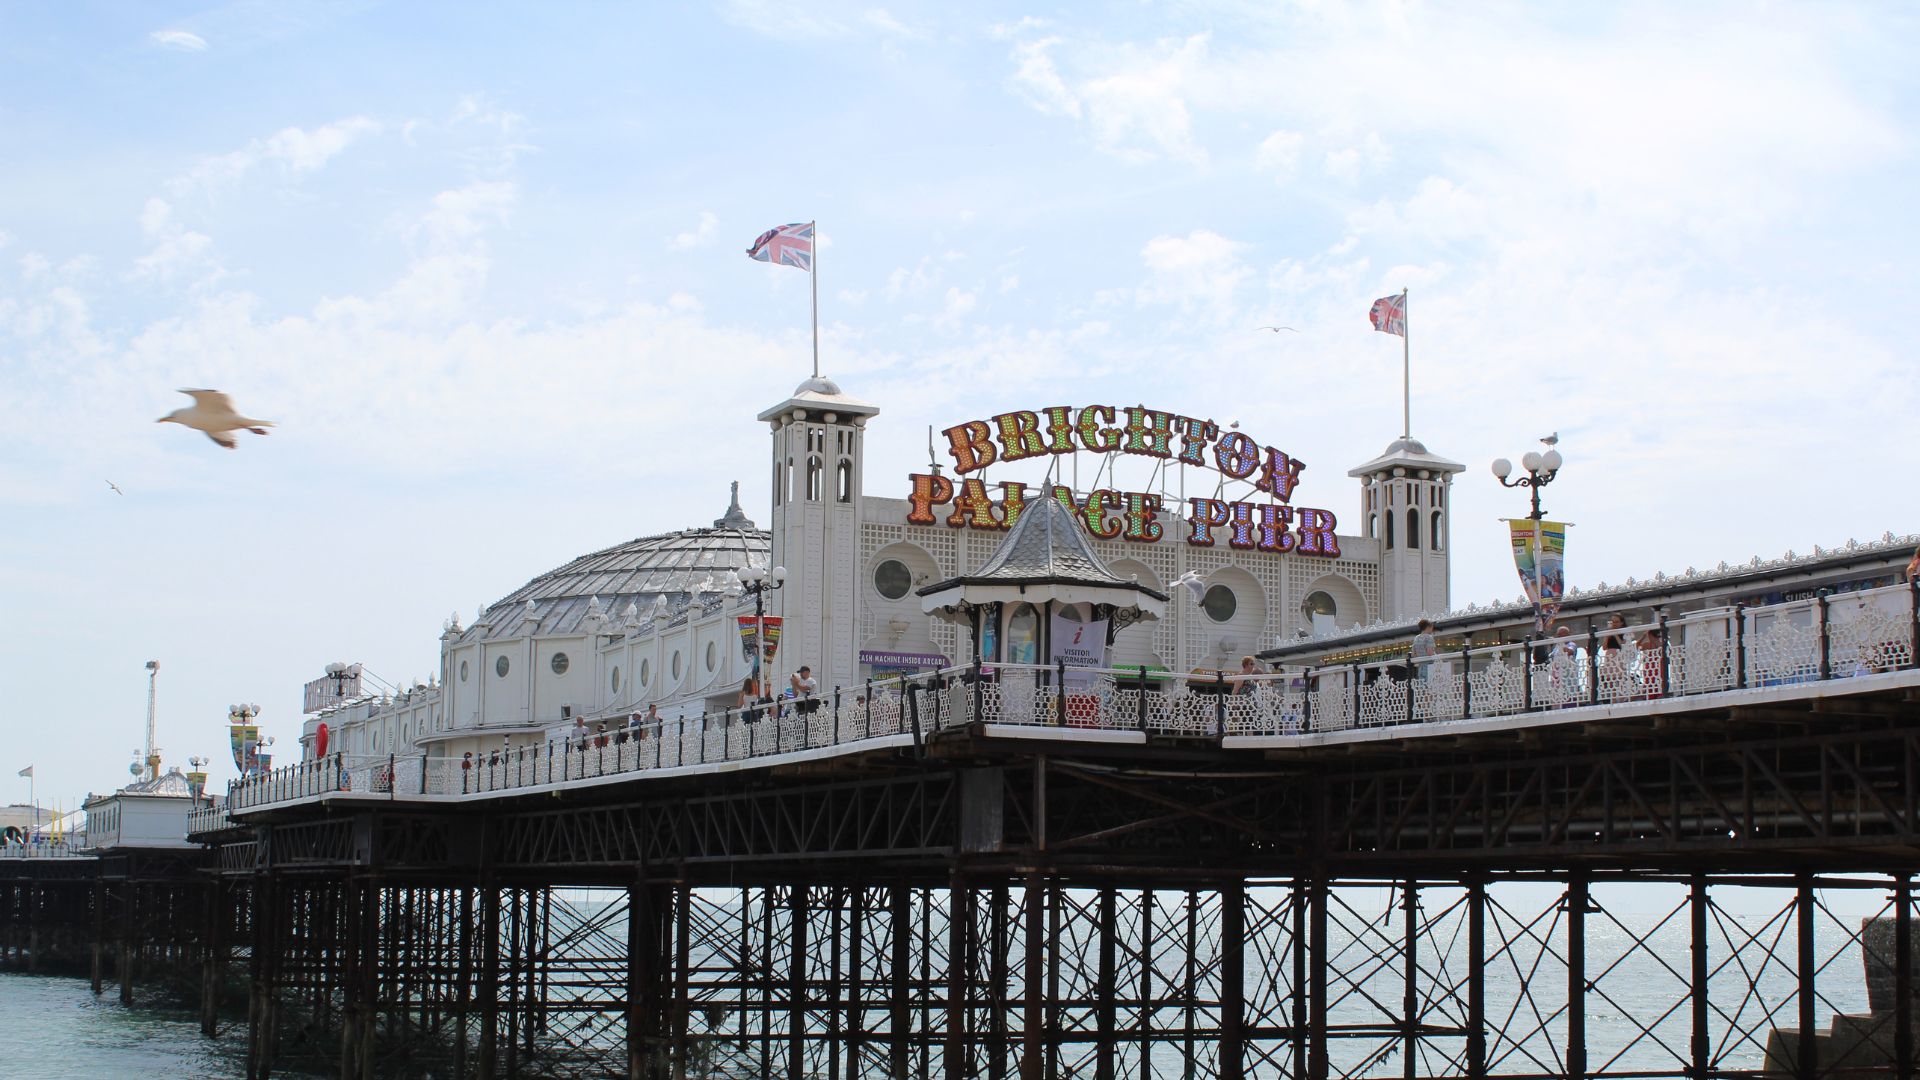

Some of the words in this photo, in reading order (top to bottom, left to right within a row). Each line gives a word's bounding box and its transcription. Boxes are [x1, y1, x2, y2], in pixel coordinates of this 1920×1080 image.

[942, 405, 1306, 502] BRIGHTON
[1187, 497, 1341, 558] PIER
[1785, 591, 1814, 602] SLUSH
[1064, 648, 1090, 657] VISITOR
[875, 655, 900, 664] MACHINE
[902, 656, 920, 665] INSIDE
[922, 657, 946, 666] ARCADE
[1054, 656, 1099, 665] INFORMATION
